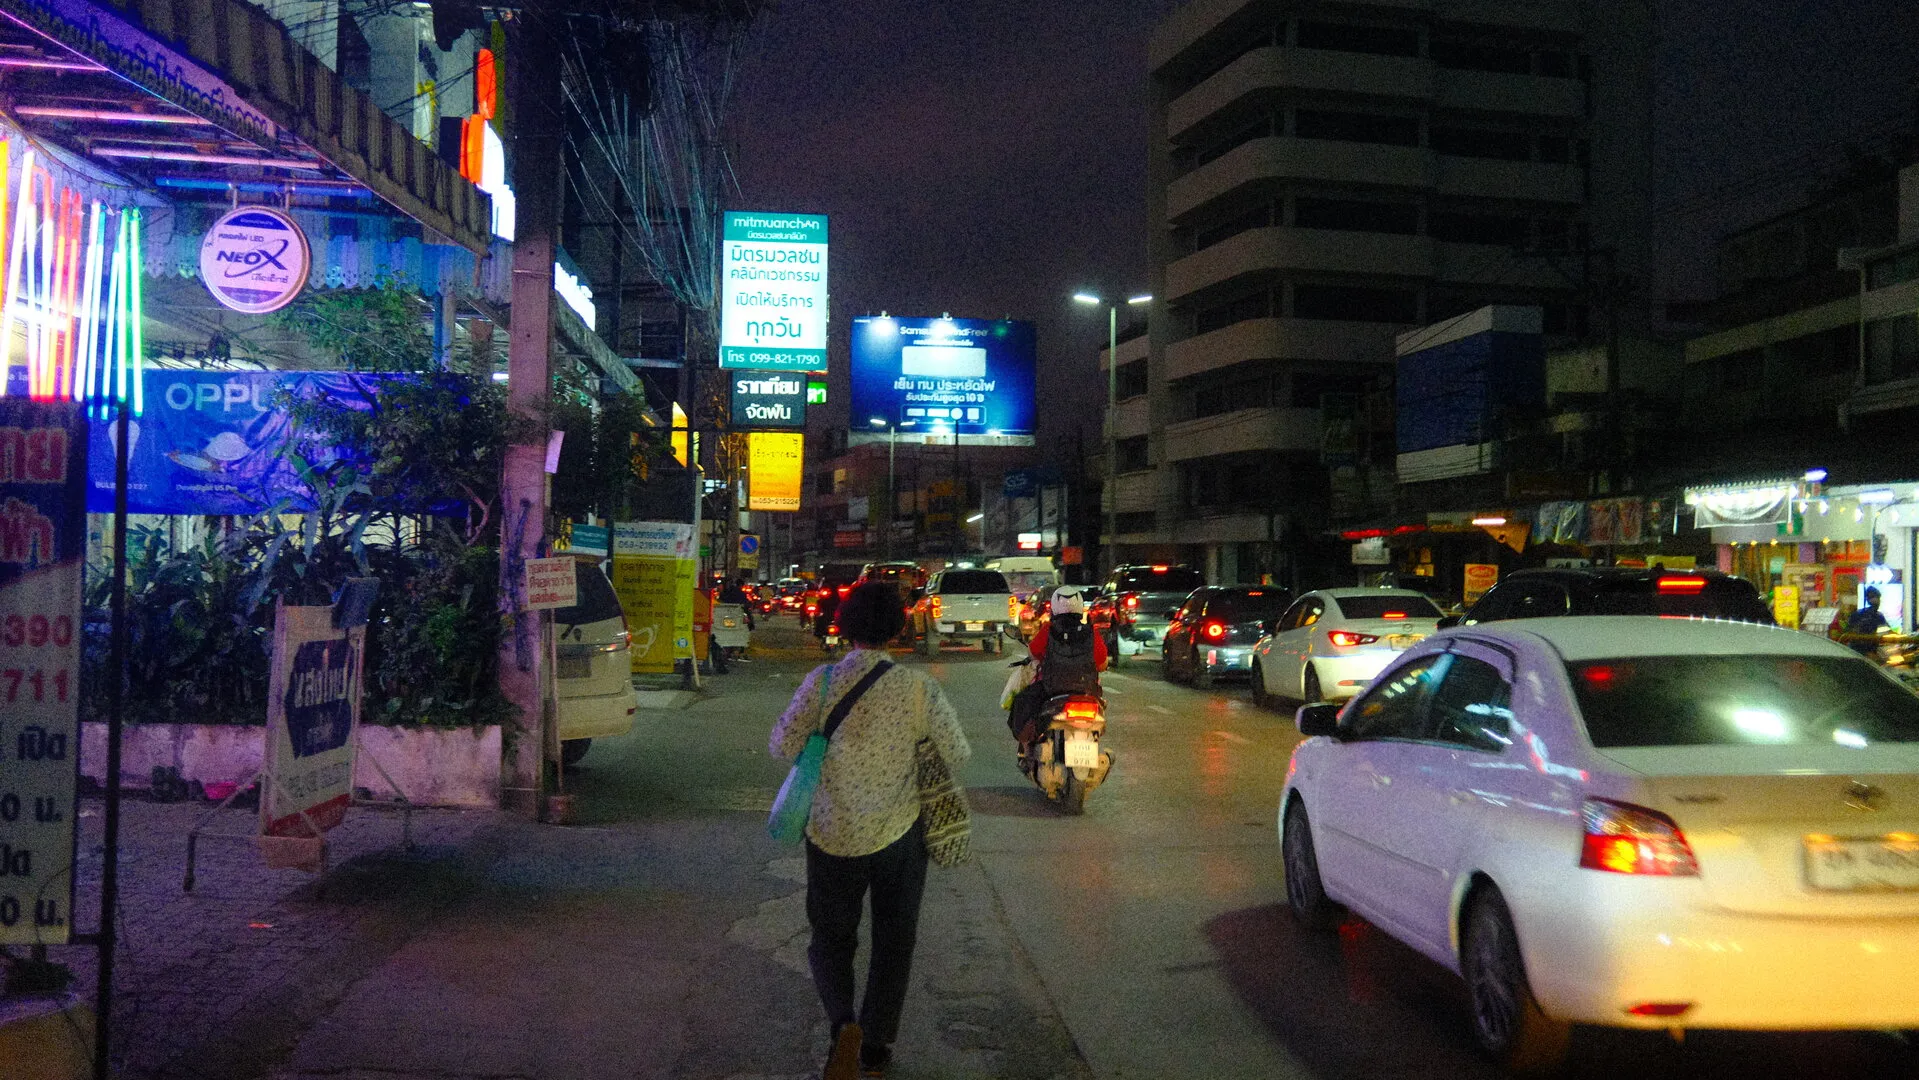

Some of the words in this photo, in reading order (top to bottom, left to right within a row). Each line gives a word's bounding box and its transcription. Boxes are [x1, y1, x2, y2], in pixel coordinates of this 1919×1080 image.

[216, 249, 288, 271] NEOX
[731, 244, 820, 264] มิตรมวลชน
[731, 266, 820, 282] คลินิกเวชกรรม
[736, 291, 813, 308] เปิดให้บริการ
[746, 316, 802, 344] ทุกวัน
[727, 350, 745, 363] โทร
[749, 352, 821, 365] 099-821-1790
[736, 376, 800, 395] รากเทียม
[894, 377, 914, 390] เย็น
[918, 381, 935, 391] ทน
[937, 379, 995, 392] ประหยัดไฟ
[165, 382, 296, 412] OPPL
[745, 402, 791, 420] จัดฟัน
